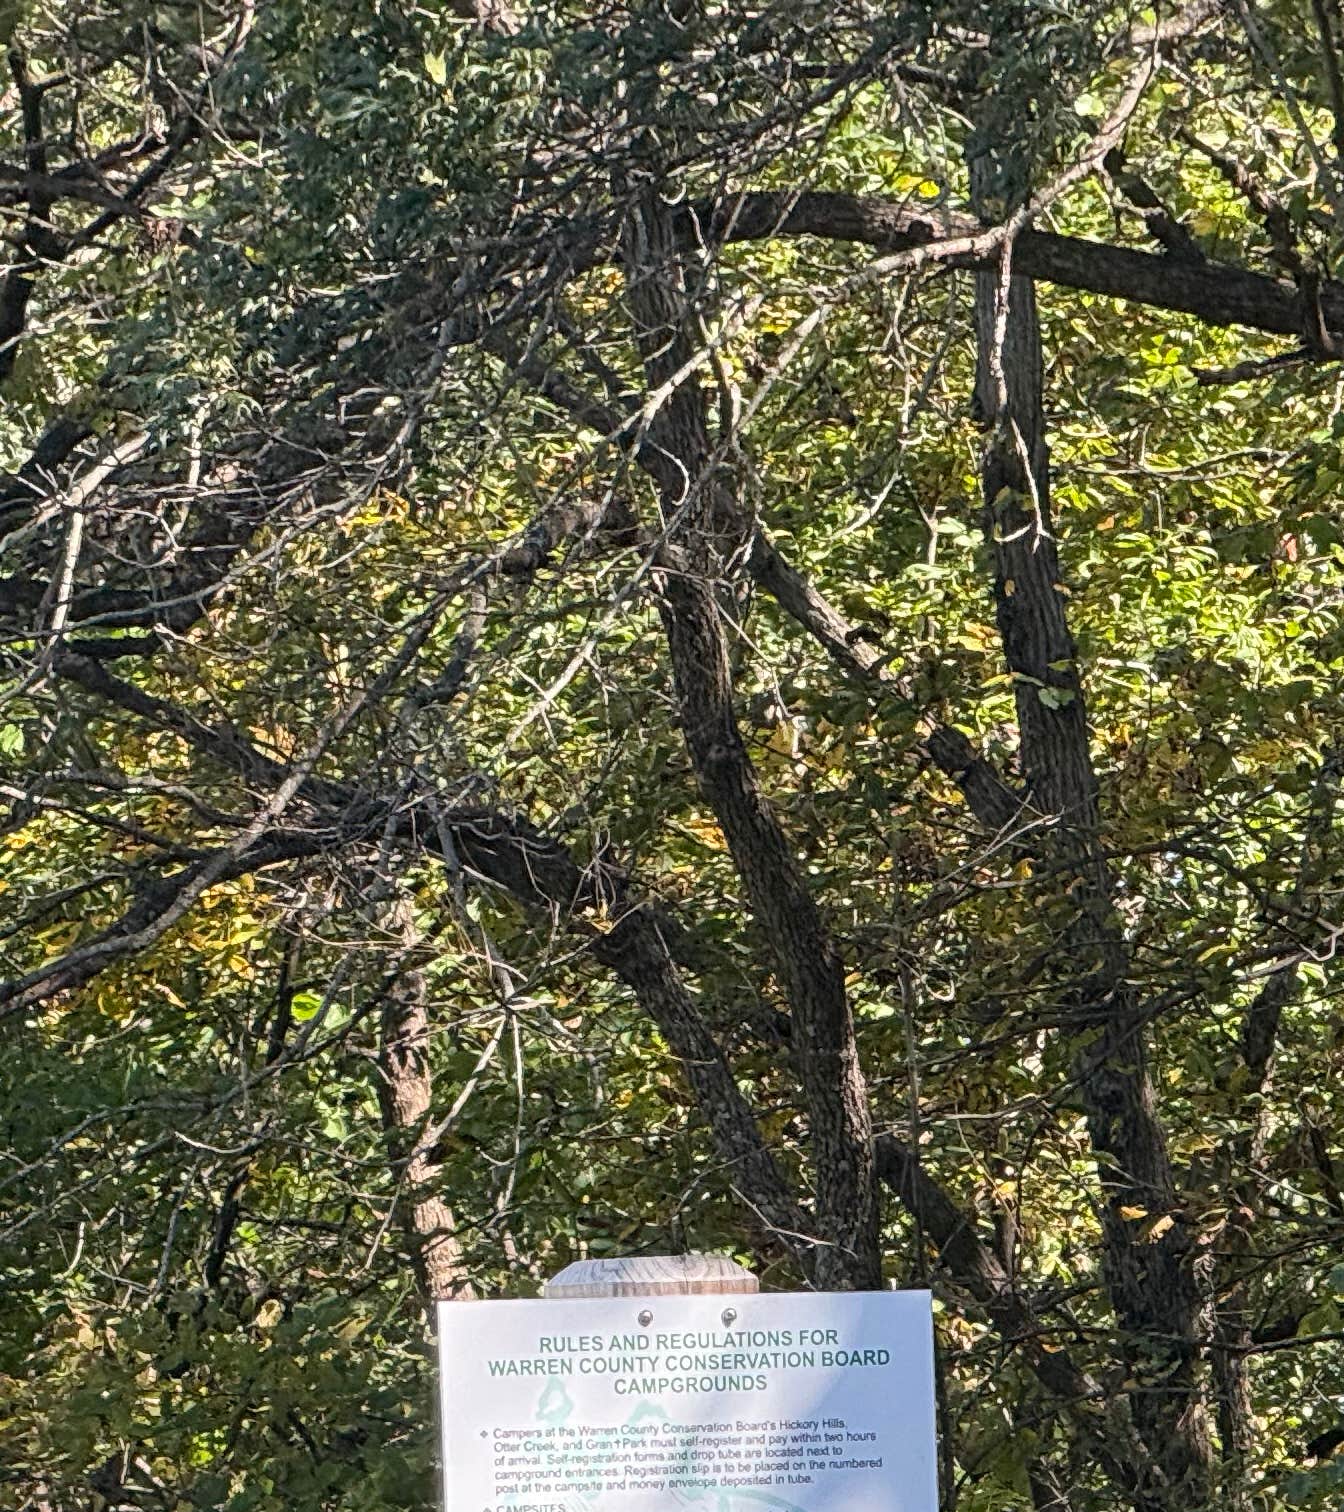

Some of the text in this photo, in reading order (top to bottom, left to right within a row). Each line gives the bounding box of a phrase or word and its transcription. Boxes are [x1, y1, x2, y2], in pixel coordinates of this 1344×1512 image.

[539, 1329, 839, 1353] RULES AND REGULATIONS FOR
[487, 1349, 890, 1376] WARREN COUNTY CONSERVATION BOARD
[613, 1374, 767, 1395] CAMPGROUNDS
[492, 1426, 542, 1441] Campers
[545, 1426, 555, 1437] at
[558, 1426, 575, 1437] the
[577, 1424, 618, 1436] Warren
[619, 1423, 659, 1437] County
[661, 1420, 733, 1434] Conservation
[735, 1419, 776, 1431] Board's
[778, 1419, 819, 1433] Hickory
[493, 1441, 521, 1453] Otter
[562, 1439, 583, 1450] and
[622, 1437, 647, 1449] Park
[650, 1436, 677, 1448] must
[679, 1434, 742, 1449] self-register
[746, 1433, 766, 1445] and
[768, 1435, 788, 1446] pay
[789, 1432, 821, 1443] within
[823, 1432, 844, 1442] two
[845, 1430, 876, 1442] hours
